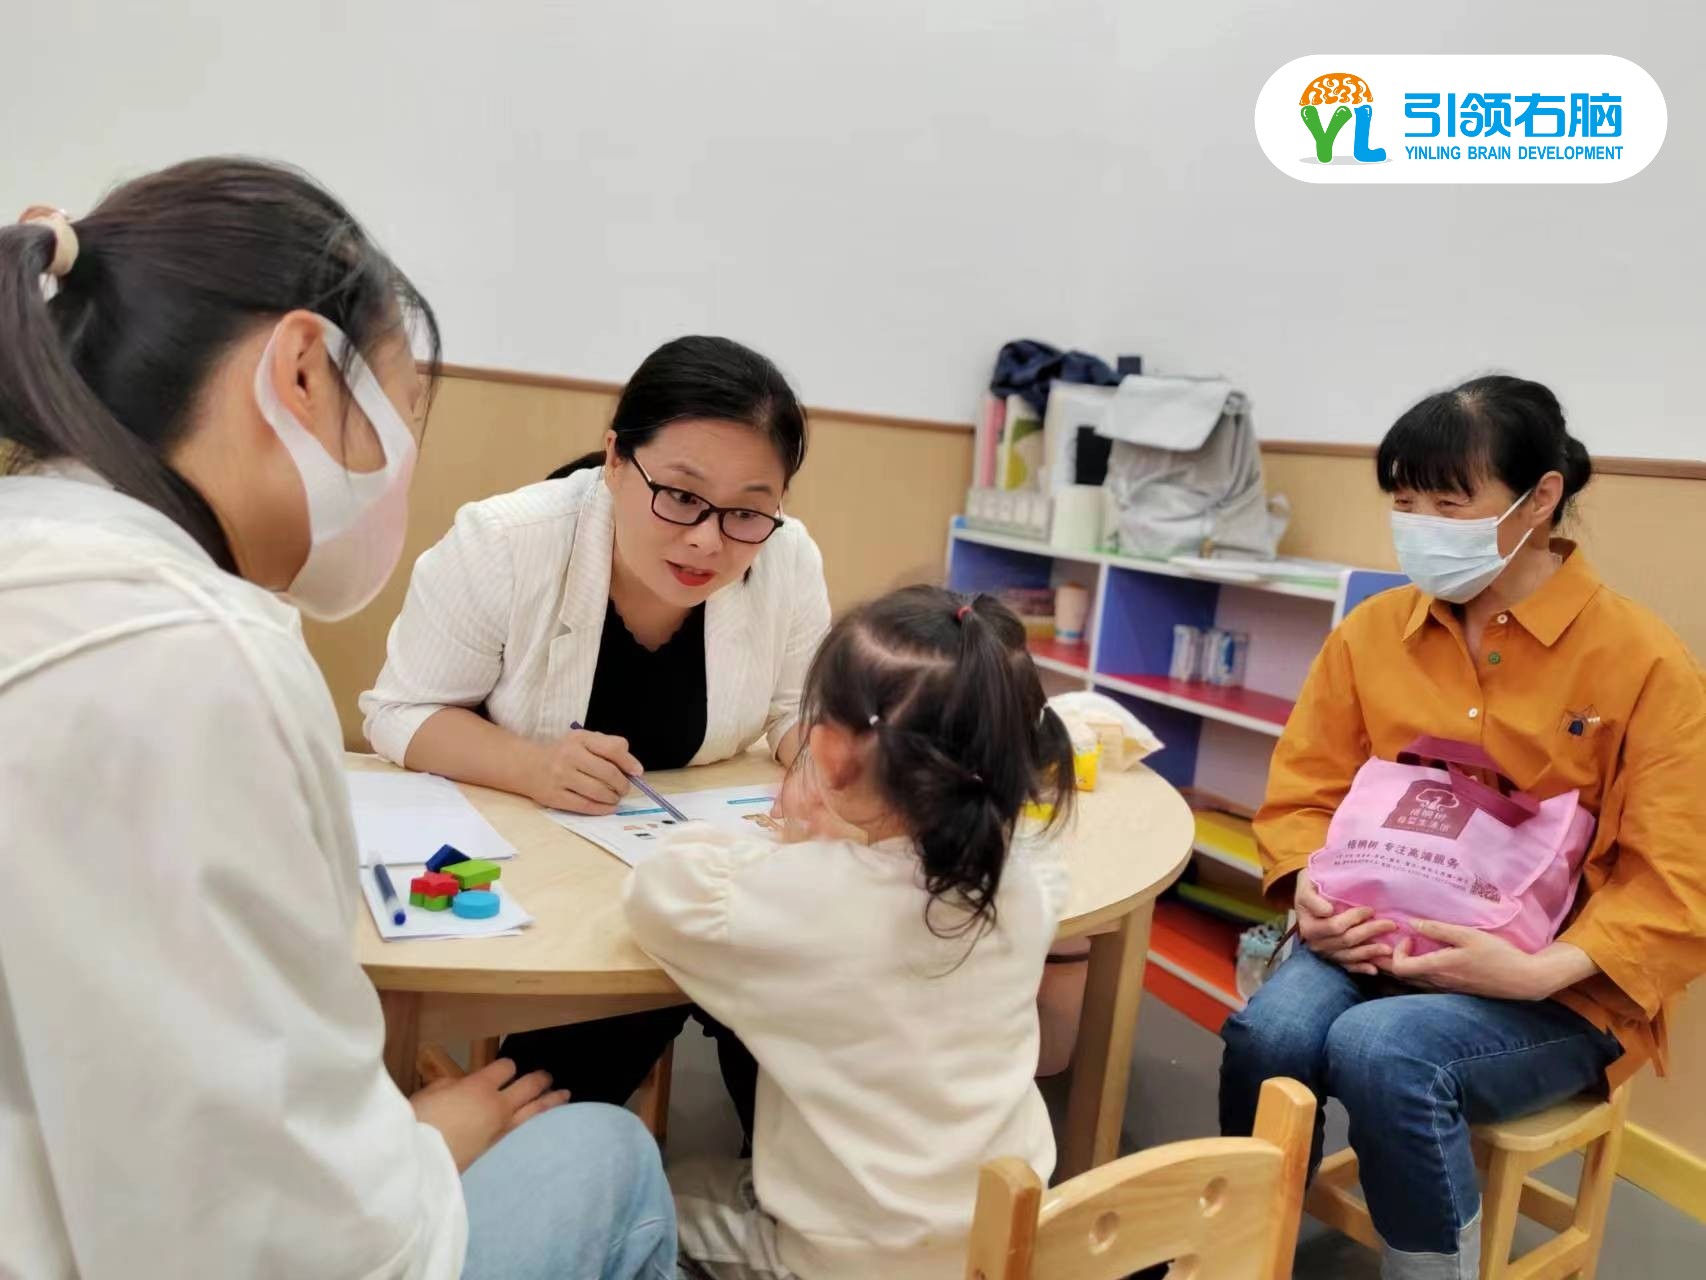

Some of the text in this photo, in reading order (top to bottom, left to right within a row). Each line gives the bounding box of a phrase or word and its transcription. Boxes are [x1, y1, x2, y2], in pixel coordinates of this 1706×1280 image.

[1384, 841, 1460, 869] 专注高端服务
